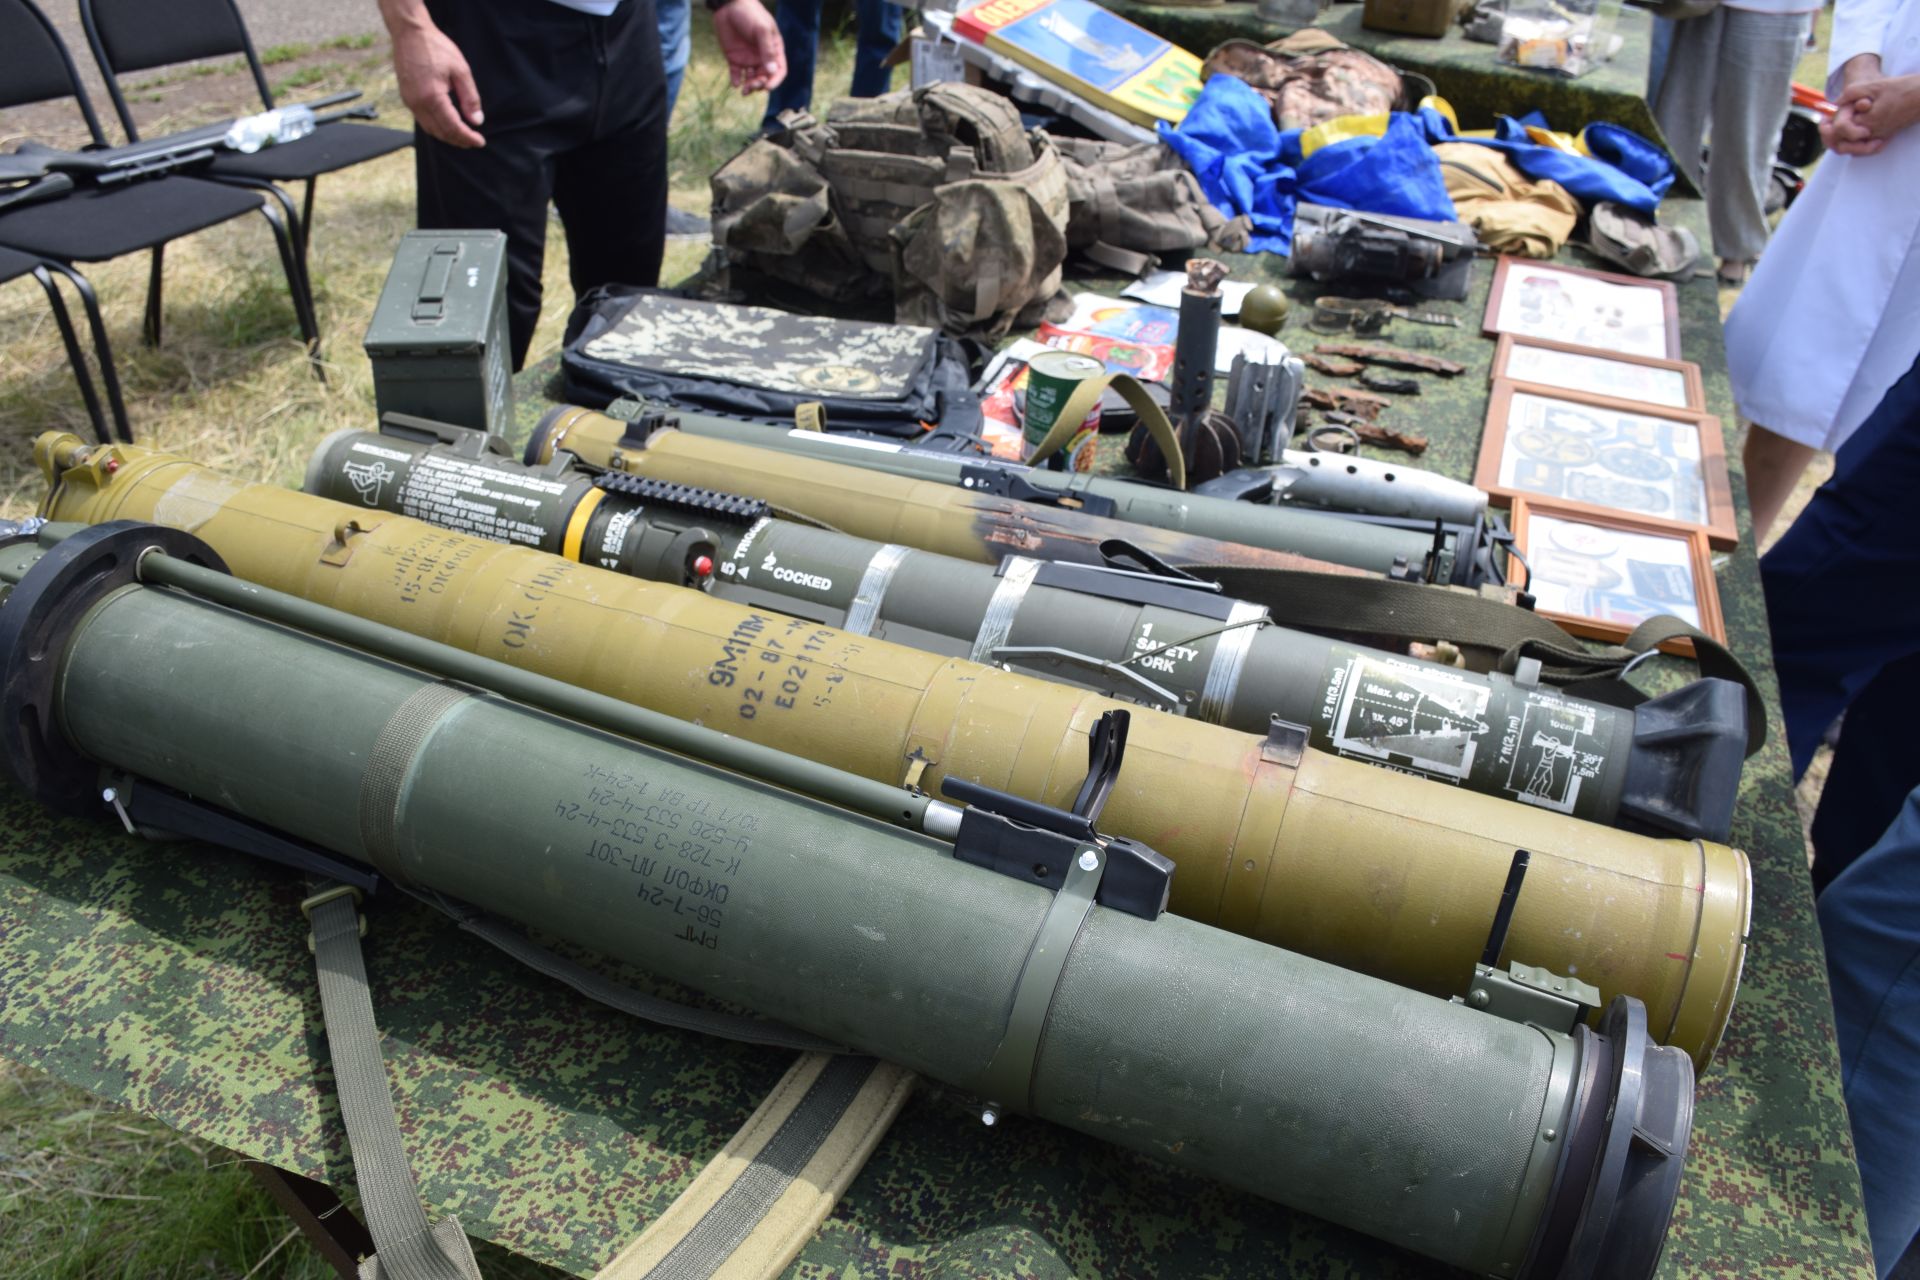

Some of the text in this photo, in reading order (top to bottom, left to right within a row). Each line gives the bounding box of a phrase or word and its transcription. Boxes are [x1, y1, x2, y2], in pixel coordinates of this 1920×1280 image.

[720, 562, 736, 576] 5
[773, 567, 832, 591] COCKED
[1141, 622, 1153, 637] 1
[1366, 683, 1393, 699] Max.
[1322, 705, 1334, 719] 12
[1499, 754, 1508, 765] 7
[555, 799, 648, 845] 533-4-24
[663, 865, 730, 904] ОКФОЛ
[674, 924, 718, 950] РМГ
